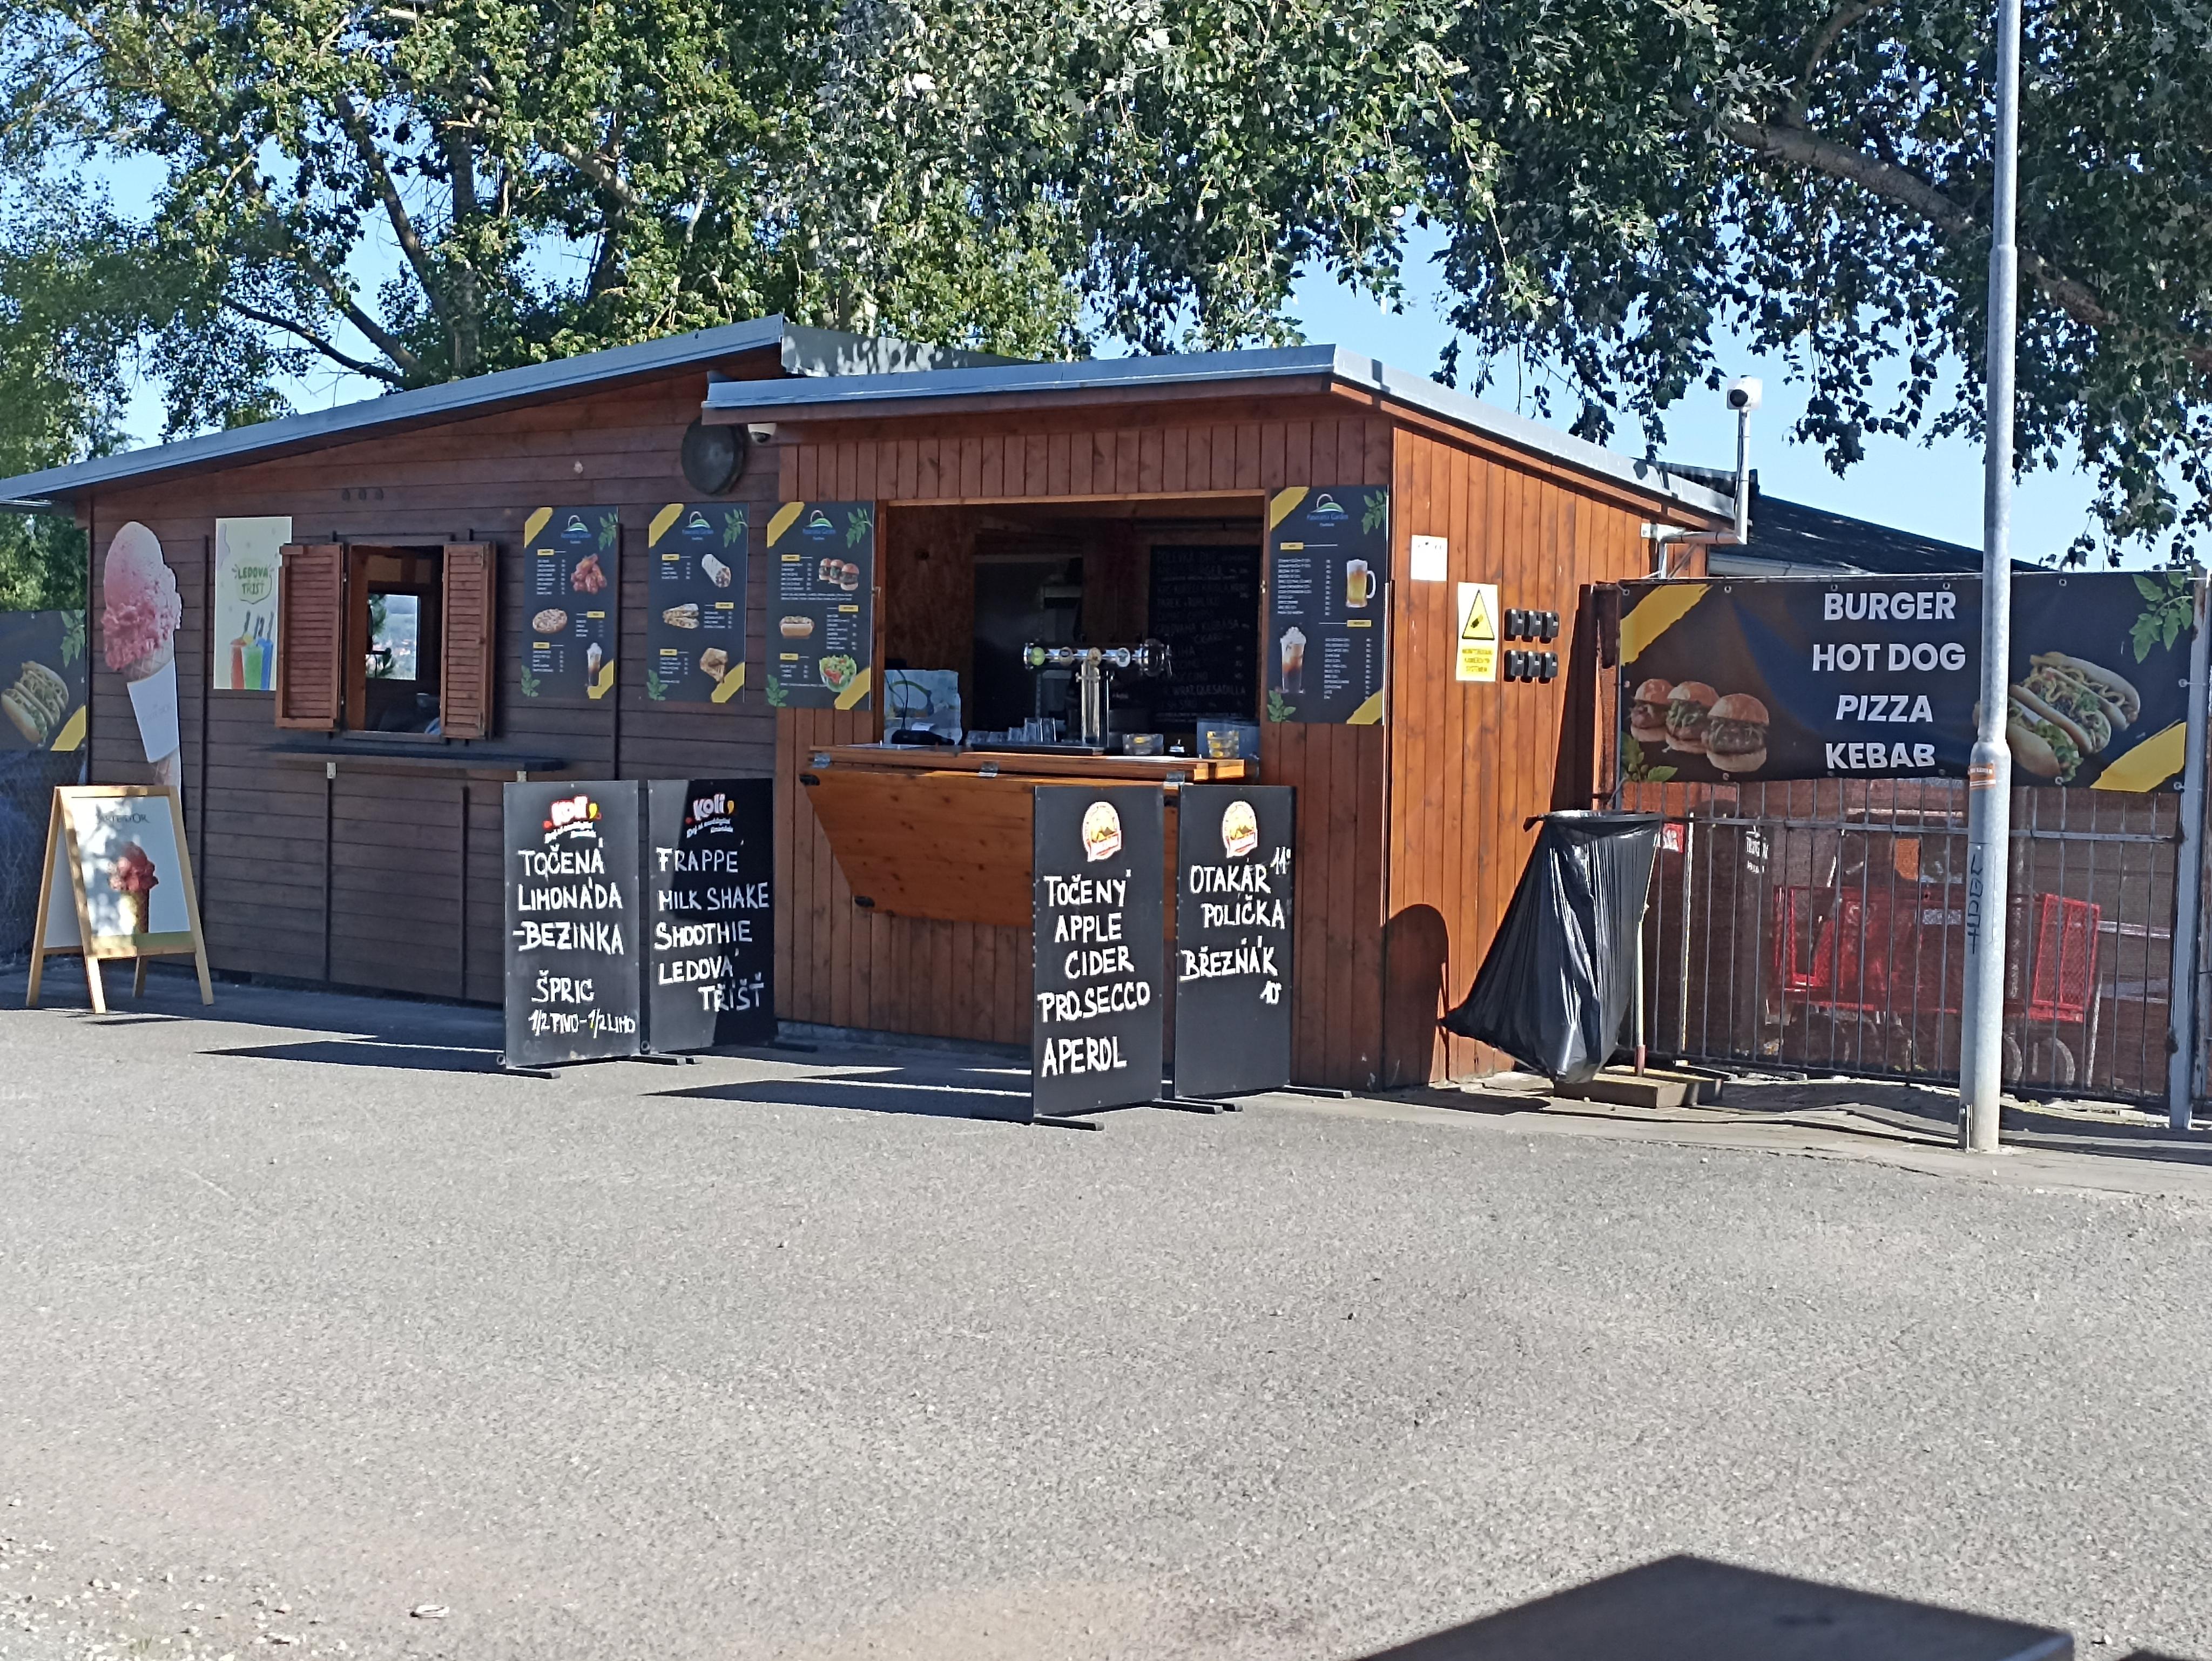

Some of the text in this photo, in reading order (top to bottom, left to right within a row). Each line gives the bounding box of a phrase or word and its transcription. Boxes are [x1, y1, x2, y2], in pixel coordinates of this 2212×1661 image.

[1824, 592, 1956, 620] BURGER
[1813, 642, 1966, 672] HOT DOG
[1836, 694, 1933, 723] PIZZA
[1826, 742, 1936, 769] KEBAB
[518, 837, 605, 882] TOČENÁ
[517, 877, 623, 911] LIMONÁDA
[658, 882, 770, 911] MILK SHAKE
[1043, 869, 1132, 907] TOČENÝ
[1054, 913, 1123, 943] APPLE
[1201, 894, 1286, 930] POLIČKA
[654, 919, 753, 951] SMOOTHIE
[658, 948, 739, 985] LEDOVÁ
[1064, 945, 1135, 980] CIDER
[531, 970, 595, 1004] ŠPRIC
[1037, 981, 1151, 1023] PROSECCO
[1041, 1036, 1128, 1077] APEROL
